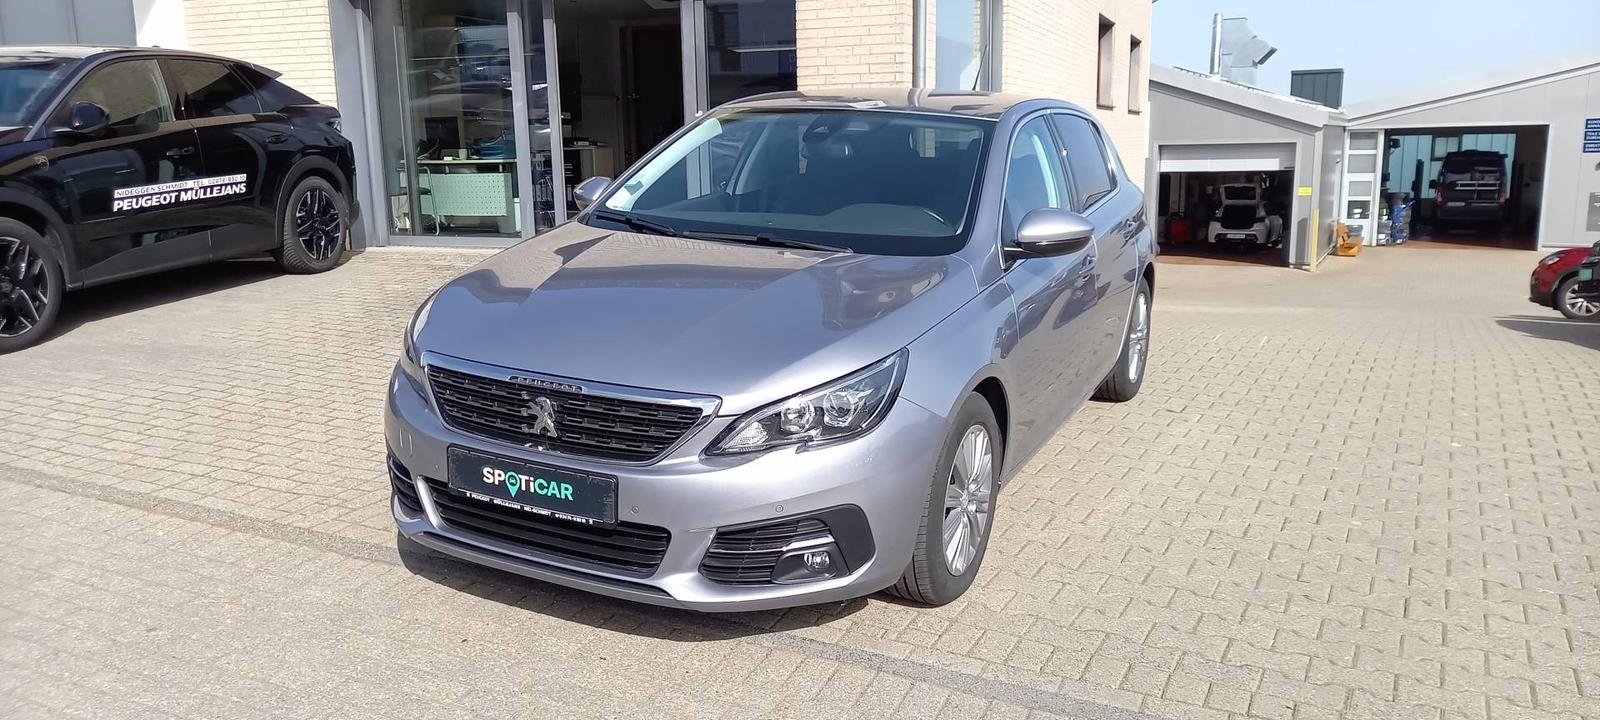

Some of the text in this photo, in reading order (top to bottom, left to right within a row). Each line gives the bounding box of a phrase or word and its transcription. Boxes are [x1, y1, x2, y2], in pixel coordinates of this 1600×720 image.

[116, 187, 156, 197] NIDEGGEN
[157, 182, 188, 191] SCHMIDT
[113, 183, 246, 212] PEUGEOT MÜLLEJANS
[518, 377, 577, 391] PEUGEOT
